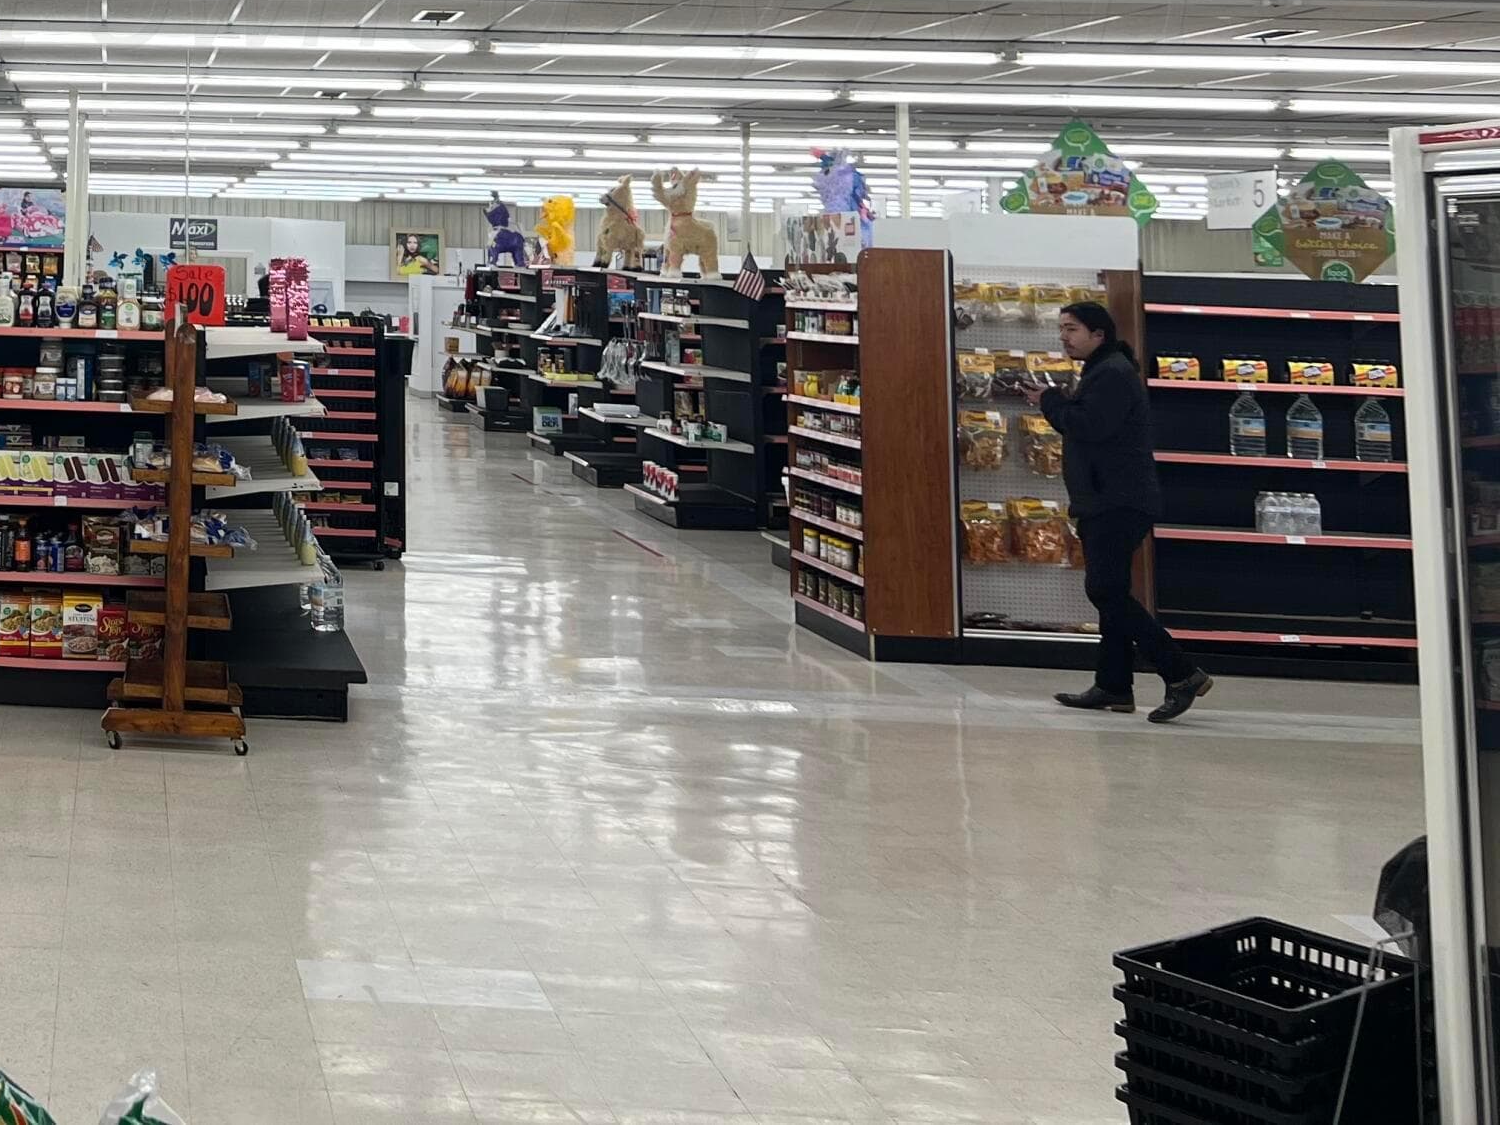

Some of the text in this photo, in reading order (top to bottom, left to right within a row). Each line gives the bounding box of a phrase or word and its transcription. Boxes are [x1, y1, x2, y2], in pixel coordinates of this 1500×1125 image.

[1252, 179, 1265, 208] 5
[171, 221, 209, 235] Maxi
[173, 265, 213, 282] Sale
